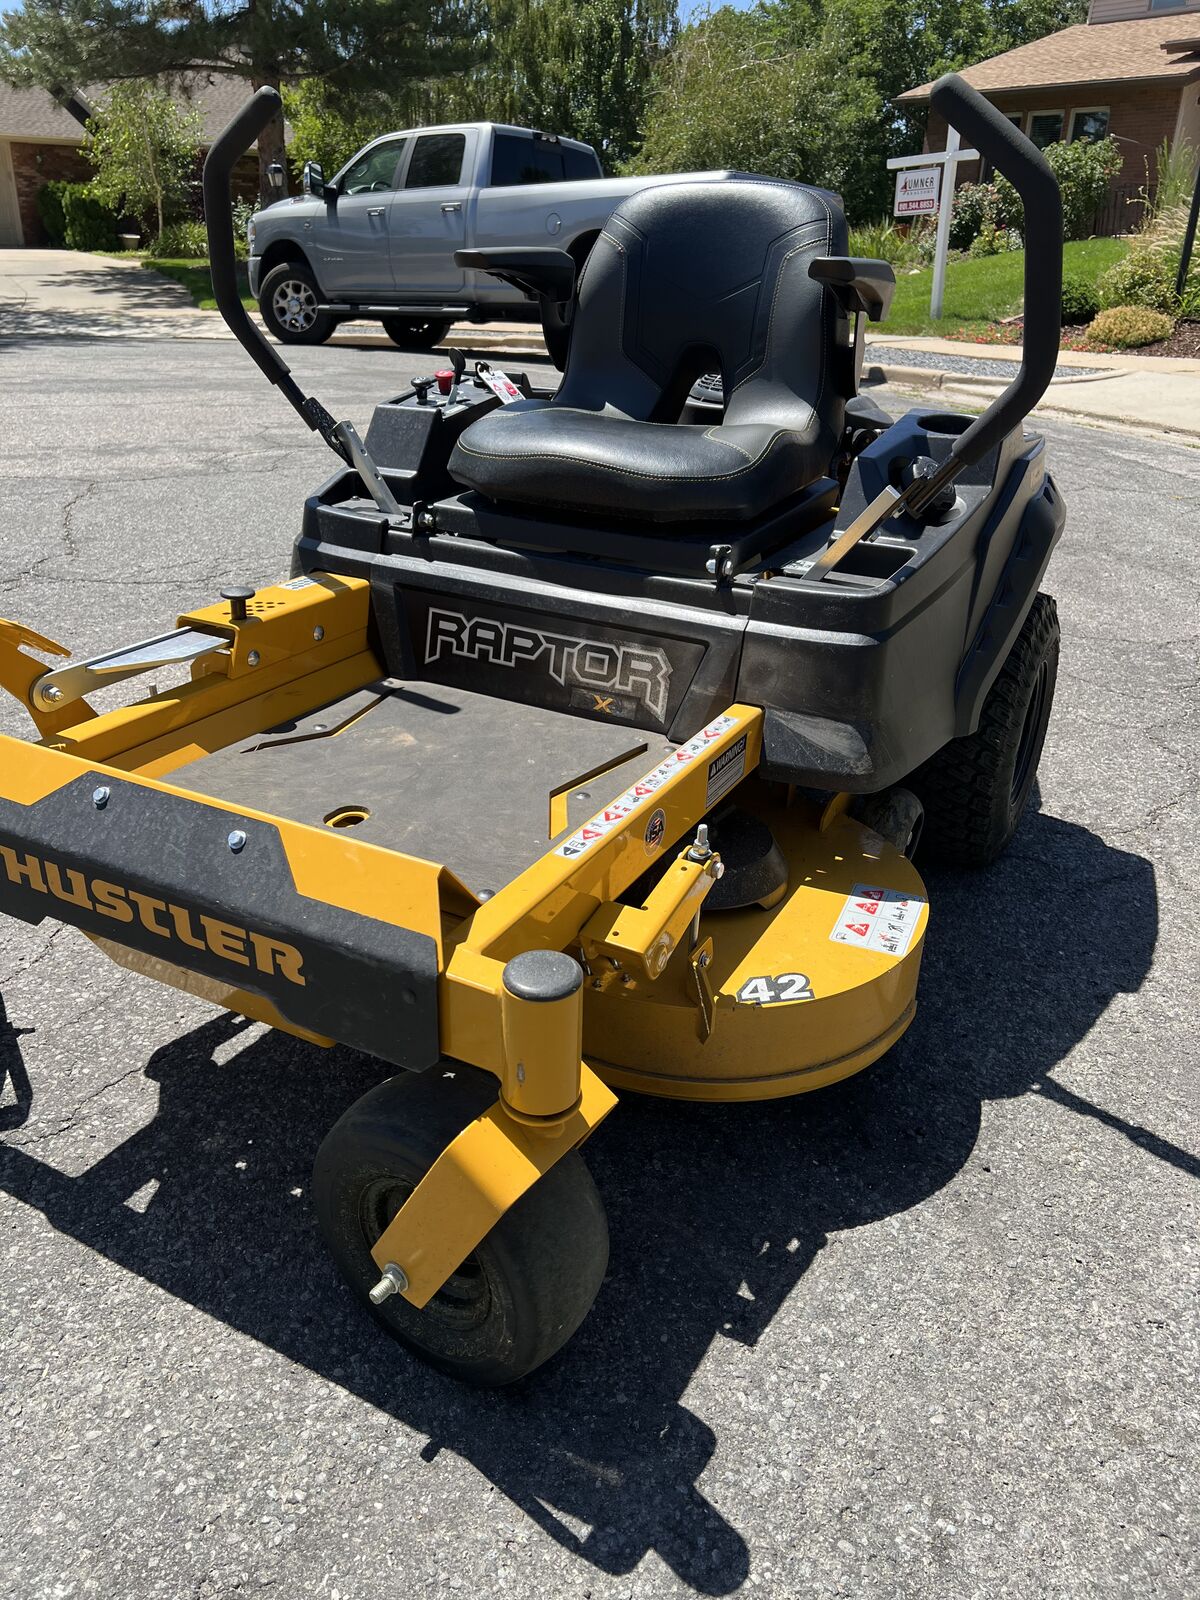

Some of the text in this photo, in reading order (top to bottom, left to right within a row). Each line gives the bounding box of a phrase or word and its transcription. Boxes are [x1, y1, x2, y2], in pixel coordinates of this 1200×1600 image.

[424, 607, 673, 724] RAPTOR
[0, 846, 306, 986] HUSTLER
[740, 973, 813, 1003] 42
